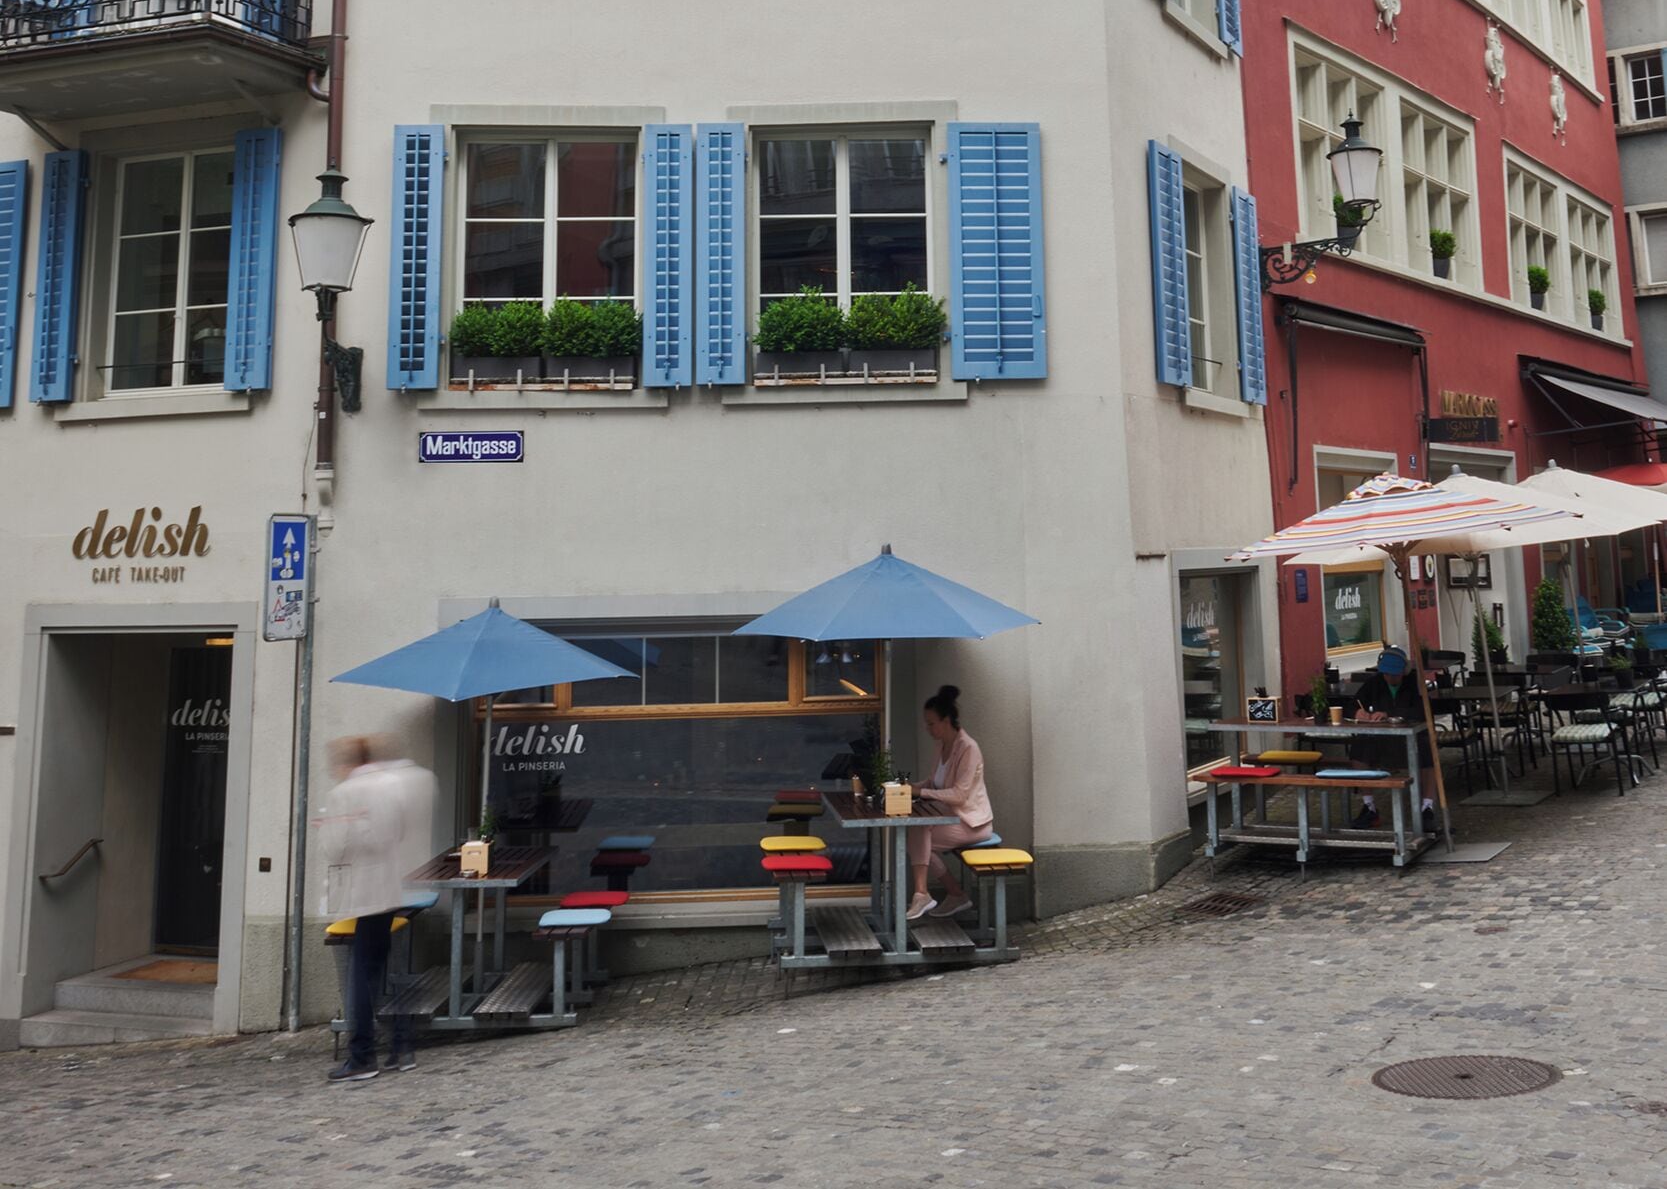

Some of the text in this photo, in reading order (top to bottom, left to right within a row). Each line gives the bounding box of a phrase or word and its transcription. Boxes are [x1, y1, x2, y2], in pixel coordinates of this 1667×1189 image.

[426, 435, 516, 459] Marktgasse
[72, 505, 210, 560] delish
[130, 566, 185, 583] TAKE-OUT
[1335, 587, 1360, 610] delish
[1186, 601, 1214, 629] delish
[171, 699, 230, 727] delis
[185, 732, 229, 740] LA PINSERI
[484, 724, 586, 756] delish
[503, 761, 566, 772] LA PINSERIA
